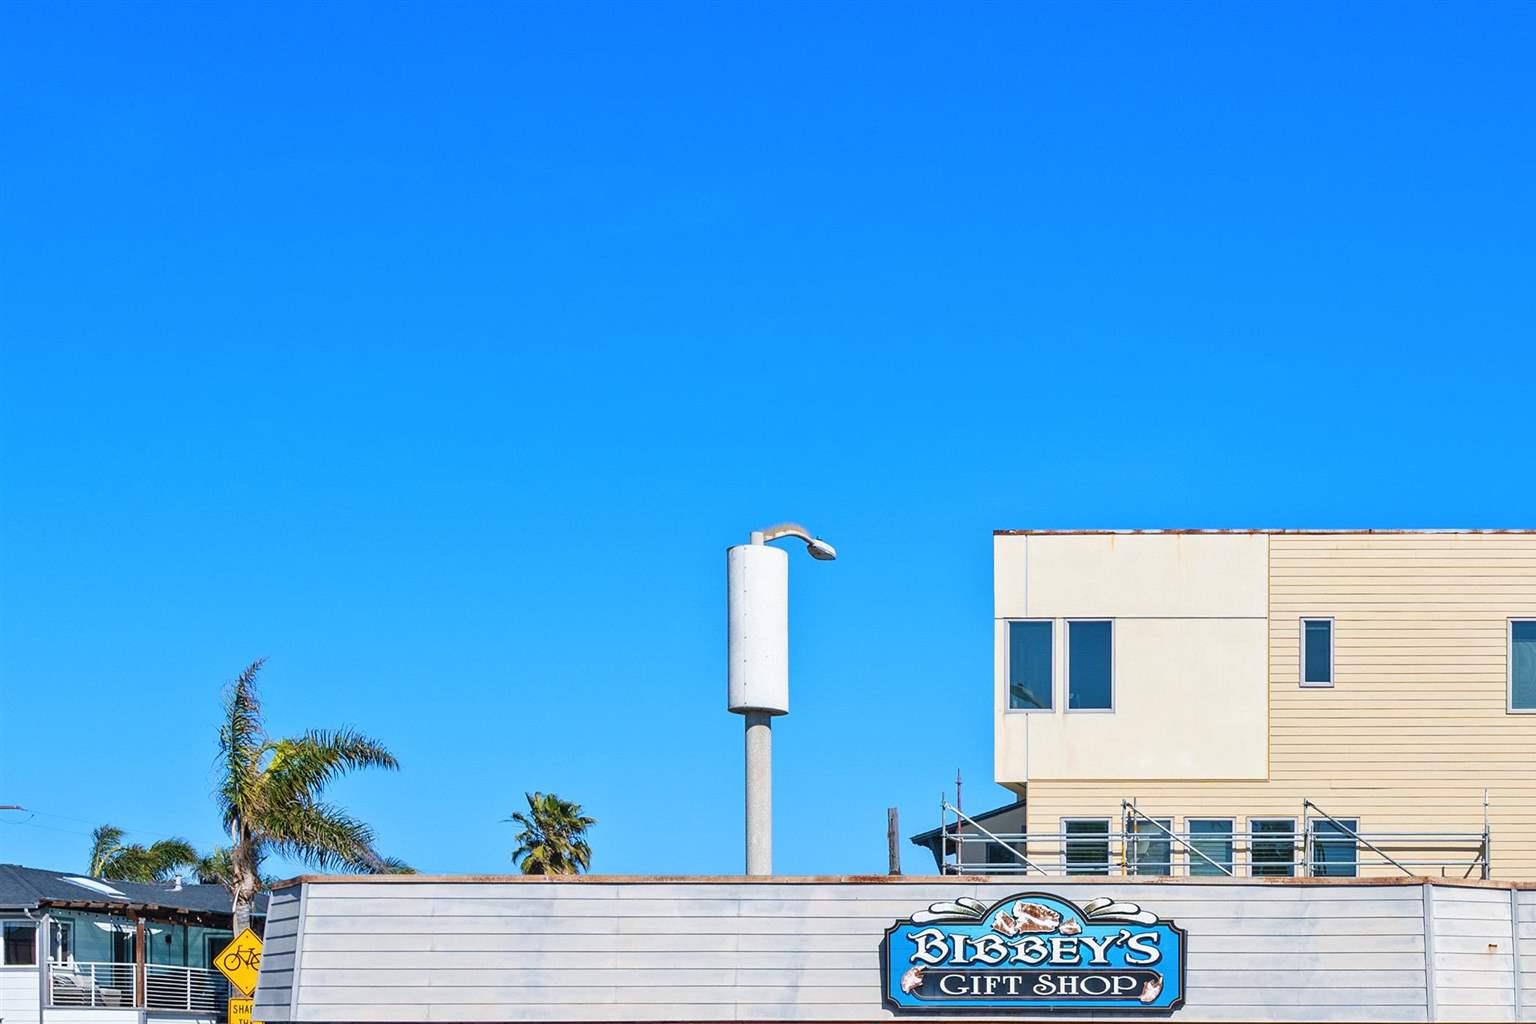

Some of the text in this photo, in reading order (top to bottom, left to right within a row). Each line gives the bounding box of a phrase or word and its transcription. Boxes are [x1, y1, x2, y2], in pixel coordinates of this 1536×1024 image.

[908, 928, 1161, 965] BIBBEY'S
[939, 973, 1138, 995] GIFT SHOP
